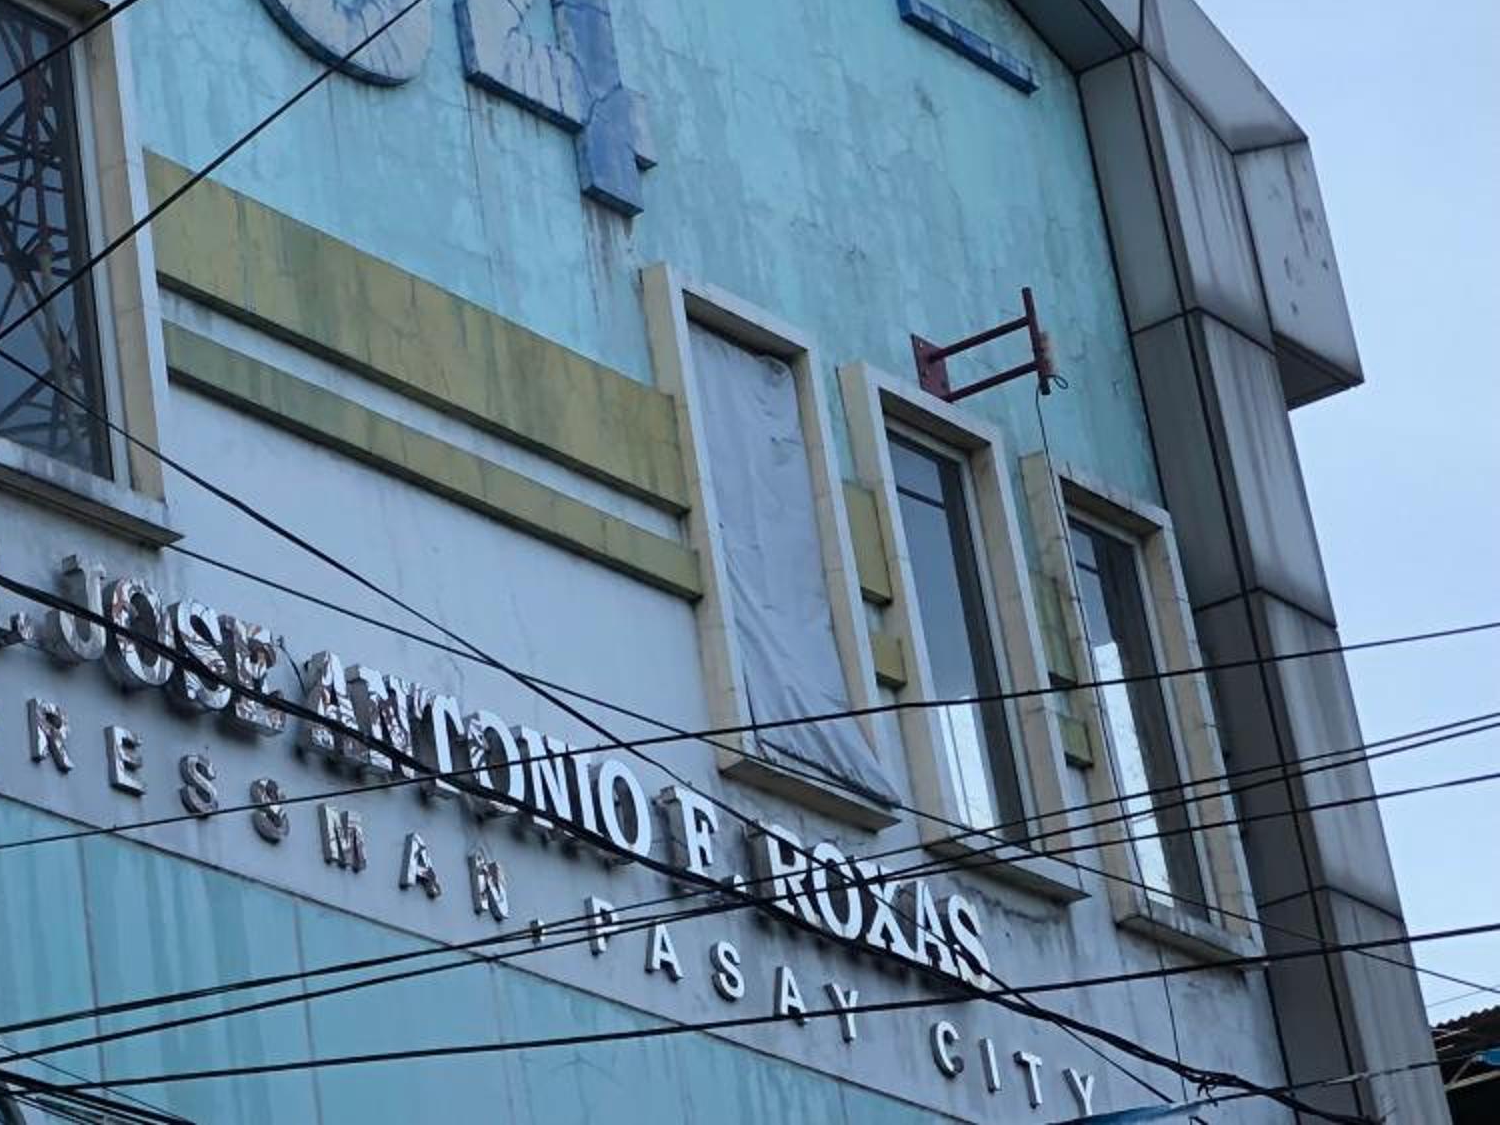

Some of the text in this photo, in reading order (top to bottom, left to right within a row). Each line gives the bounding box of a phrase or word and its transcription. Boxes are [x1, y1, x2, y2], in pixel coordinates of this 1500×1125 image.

[46, 554, 288, 737] JOSE
[305, 650, 653, 865] ANTONIO
[744, 821, 993, 993] ROXAS
[584, 896, 859, 1043] PASAY
[930, 1021, 1096, 1118] CITY
